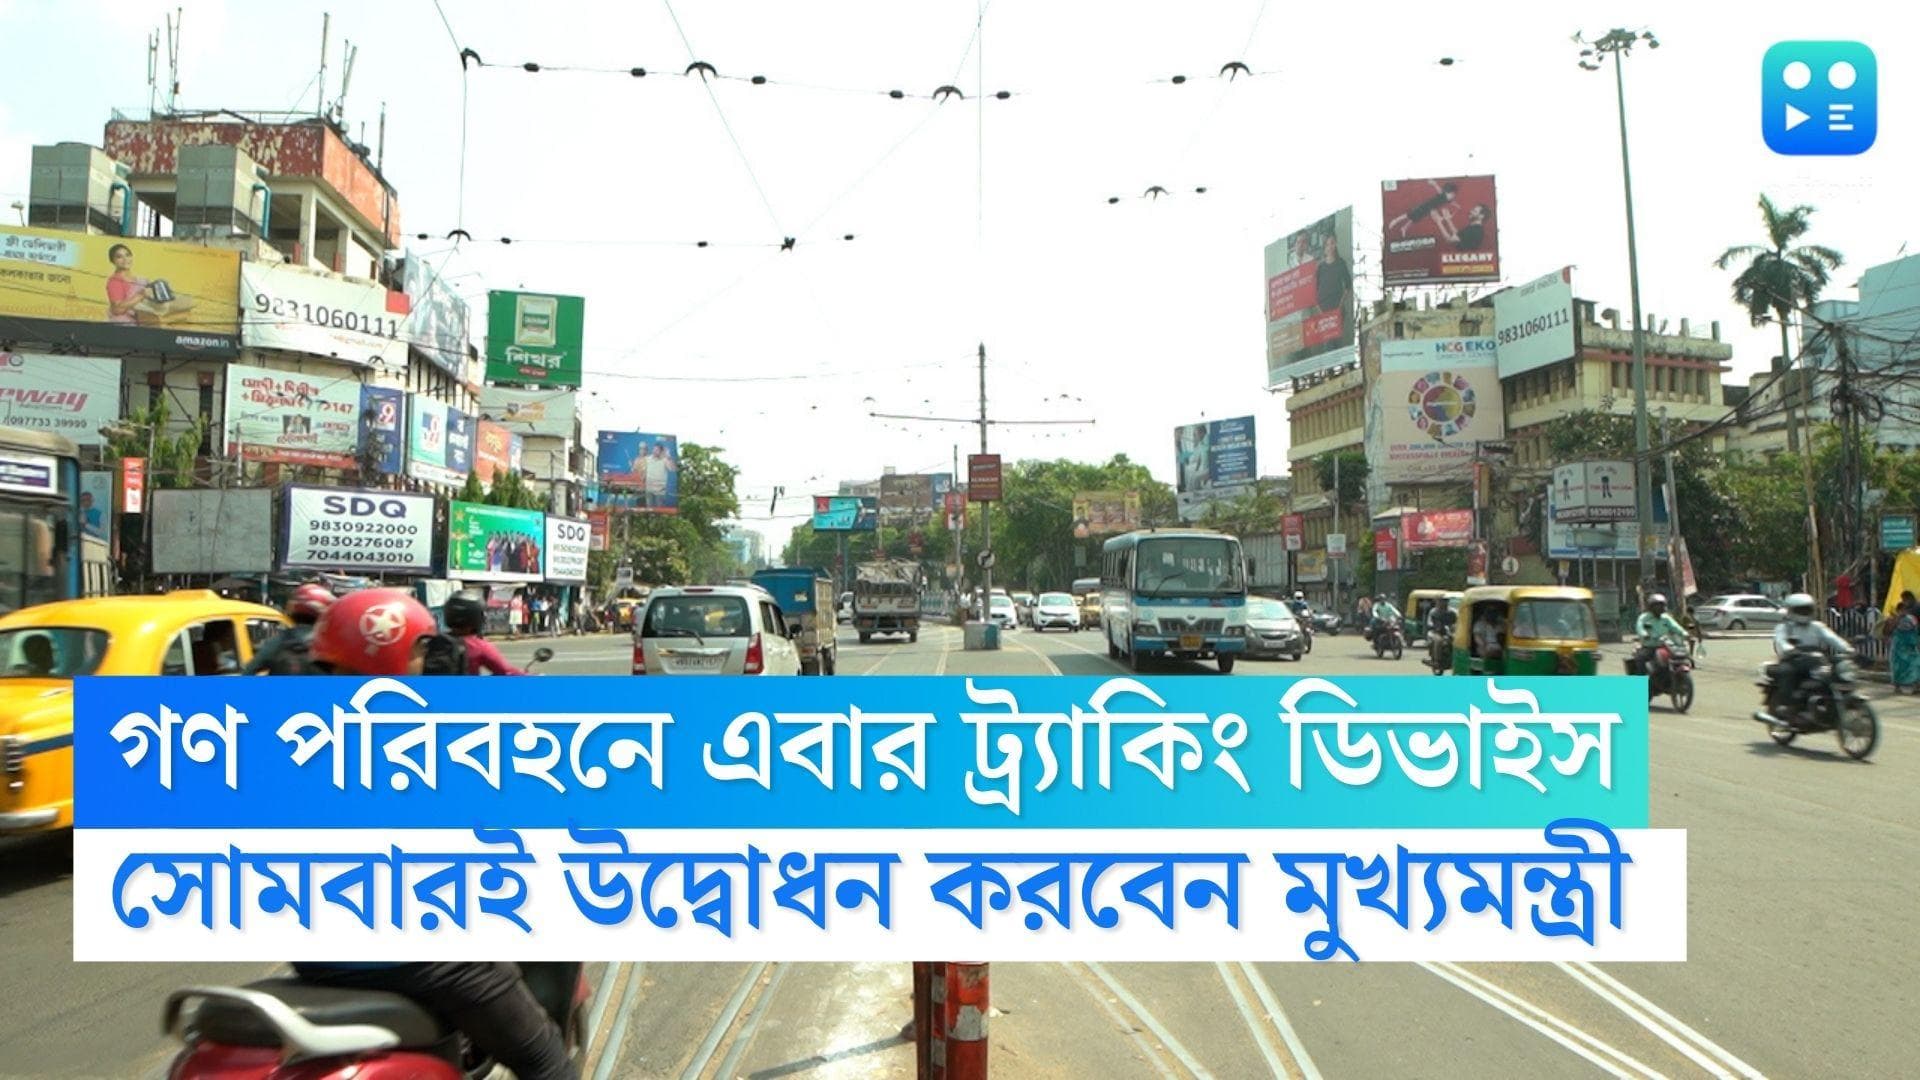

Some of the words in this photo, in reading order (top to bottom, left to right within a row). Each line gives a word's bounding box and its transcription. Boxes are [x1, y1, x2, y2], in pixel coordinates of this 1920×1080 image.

[1498, 308, 1569, 346] 9831060111
[175, 335, 230, 347] amazon.in
[323, 495, 407, 519] SDQ
[309, 520, 418, 535] 9830922000
[557, 523, 585, 541] SDQ
[308, 534, 413, 549] 9830276087
[306, 549, 414, 563] 7044043010
